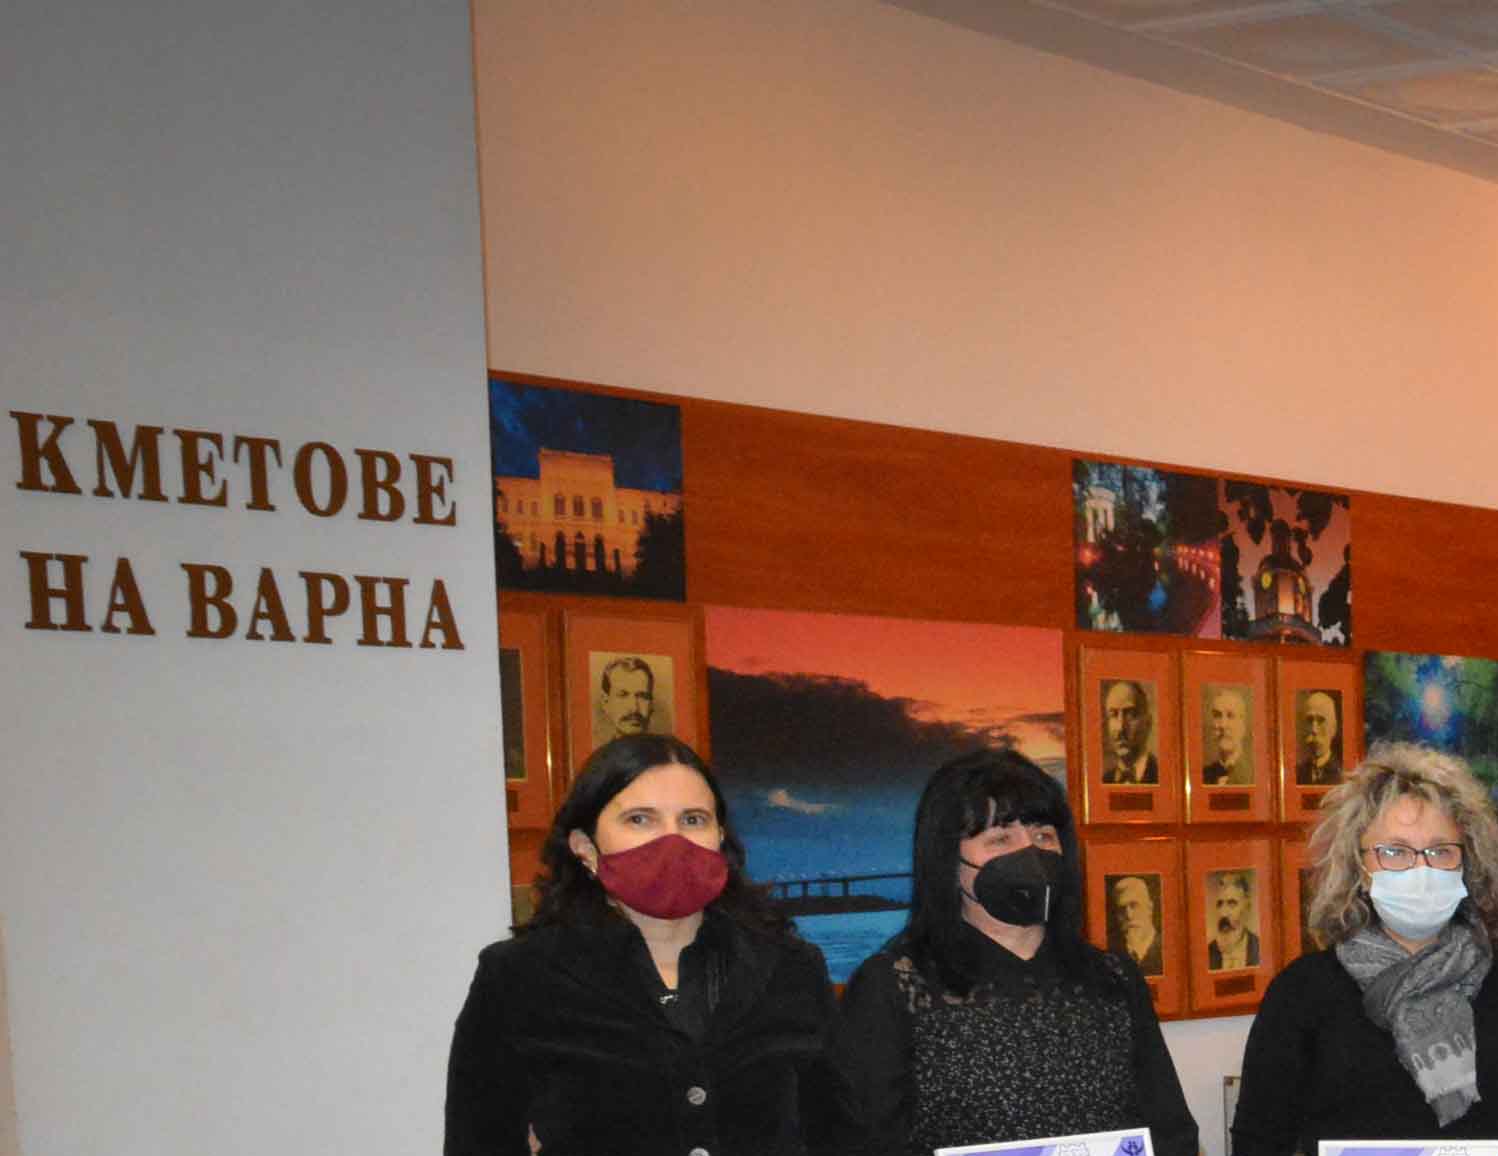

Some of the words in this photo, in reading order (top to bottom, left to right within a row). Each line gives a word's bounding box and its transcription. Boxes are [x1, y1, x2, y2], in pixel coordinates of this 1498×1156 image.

[9, 410, 457, 527] КМЕТОВЕ
[19, 550, 156, 637] НА
[180, 561, 465, 651] ВАРНА
